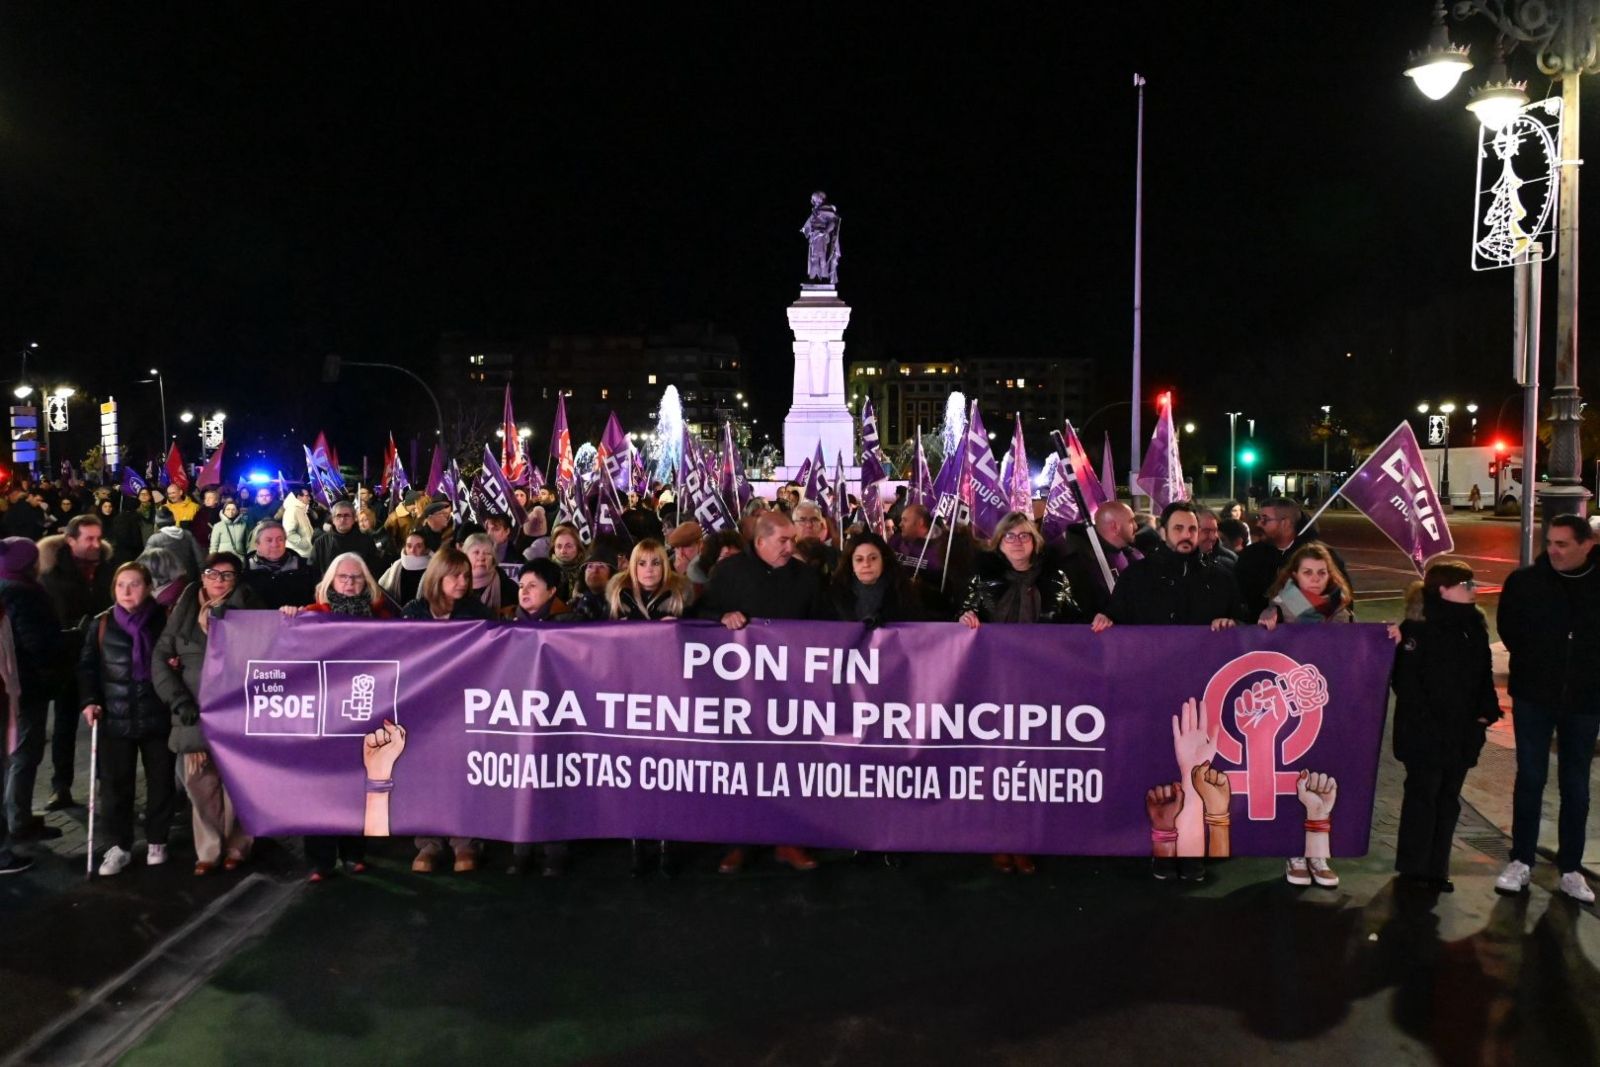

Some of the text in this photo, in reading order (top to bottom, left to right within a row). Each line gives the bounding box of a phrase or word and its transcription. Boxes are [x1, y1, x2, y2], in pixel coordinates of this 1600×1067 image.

[969, 478, 1006, 510] mujer
[253, 668, 286, 680] Castilla
[683, 642, 879, 685] PON FIN
[254, 682, 284, 694] y León
[253, 695, 316, 718] PSOE
[464, 688, 1105, 742] PARA TENER UN PRINCIPIO
[467, 750, 1103, 803] SOCIALISTAS CONTRA LA VIOLENCIA DE GÉNERO
